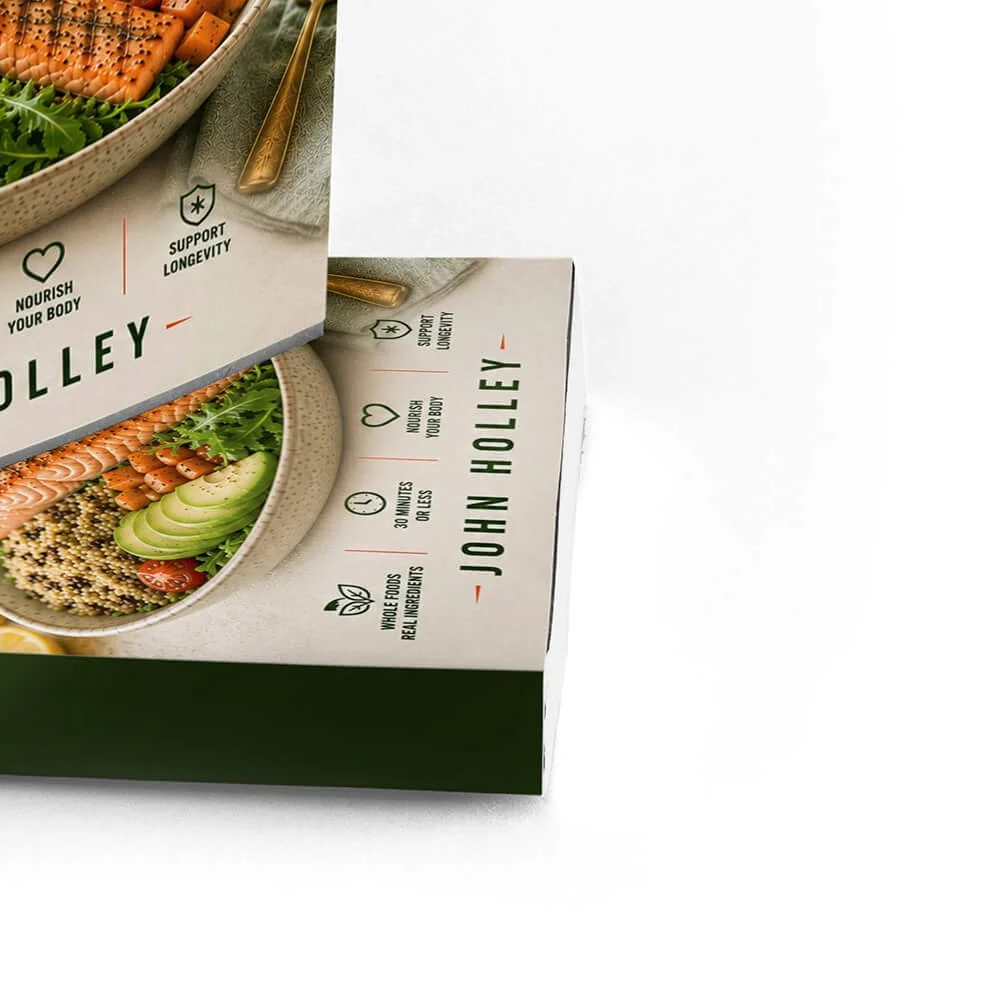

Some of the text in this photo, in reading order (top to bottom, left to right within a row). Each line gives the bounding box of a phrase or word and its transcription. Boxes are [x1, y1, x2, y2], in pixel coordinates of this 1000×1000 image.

[163, 238, 232, 277] LONGEVITY
[169, 221, 226, 256] SUPPORT
[7, 296, 81, 335] YOUR BODY
[15, 280, 73, 313] NOURISH
[417, 314, 434, 347] SUPPORT
[436, 311, 454, 351] LONGEVITY
[405, 399, 424, 434] NOURISH
[425, 395, 444, 439] YOUR BODY
[459, 358, 521, 577] JOHN HOLLEY
[393, 481, 414, 529] 30 MINUTES
[415, 489, 433, 522] OR LESS
[380, 573, 402, 631] WHOLE FOODS
[400, 566, 424, 641] REAL INGREDIENTS
